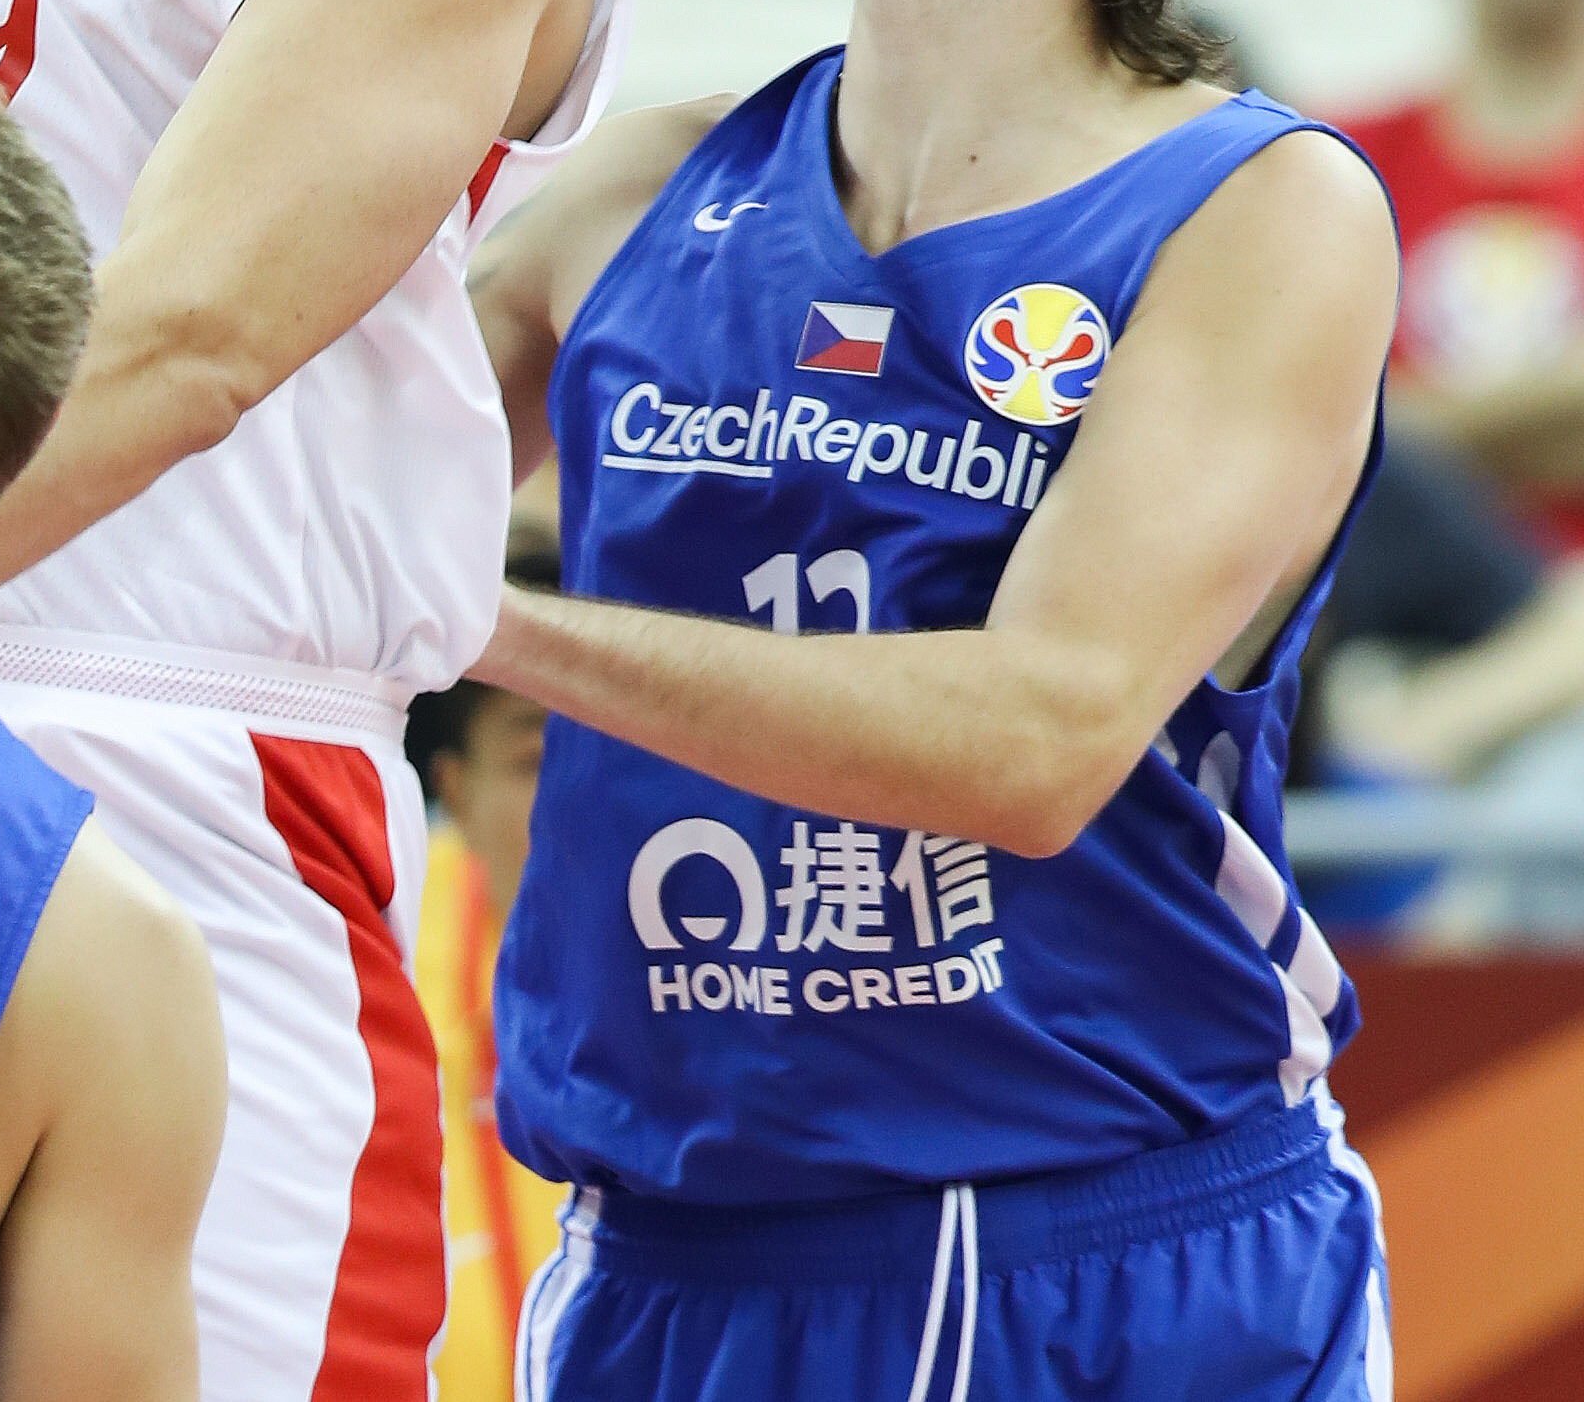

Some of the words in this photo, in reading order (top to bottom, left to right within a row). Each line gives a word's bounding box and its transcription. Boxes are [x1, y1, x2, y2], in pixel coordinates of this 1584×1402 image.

[774, 820, 996, 953] 捷信
[646, 962, 794, 1016] HOME
[801, 937, 1004, 1014] CREDIT
